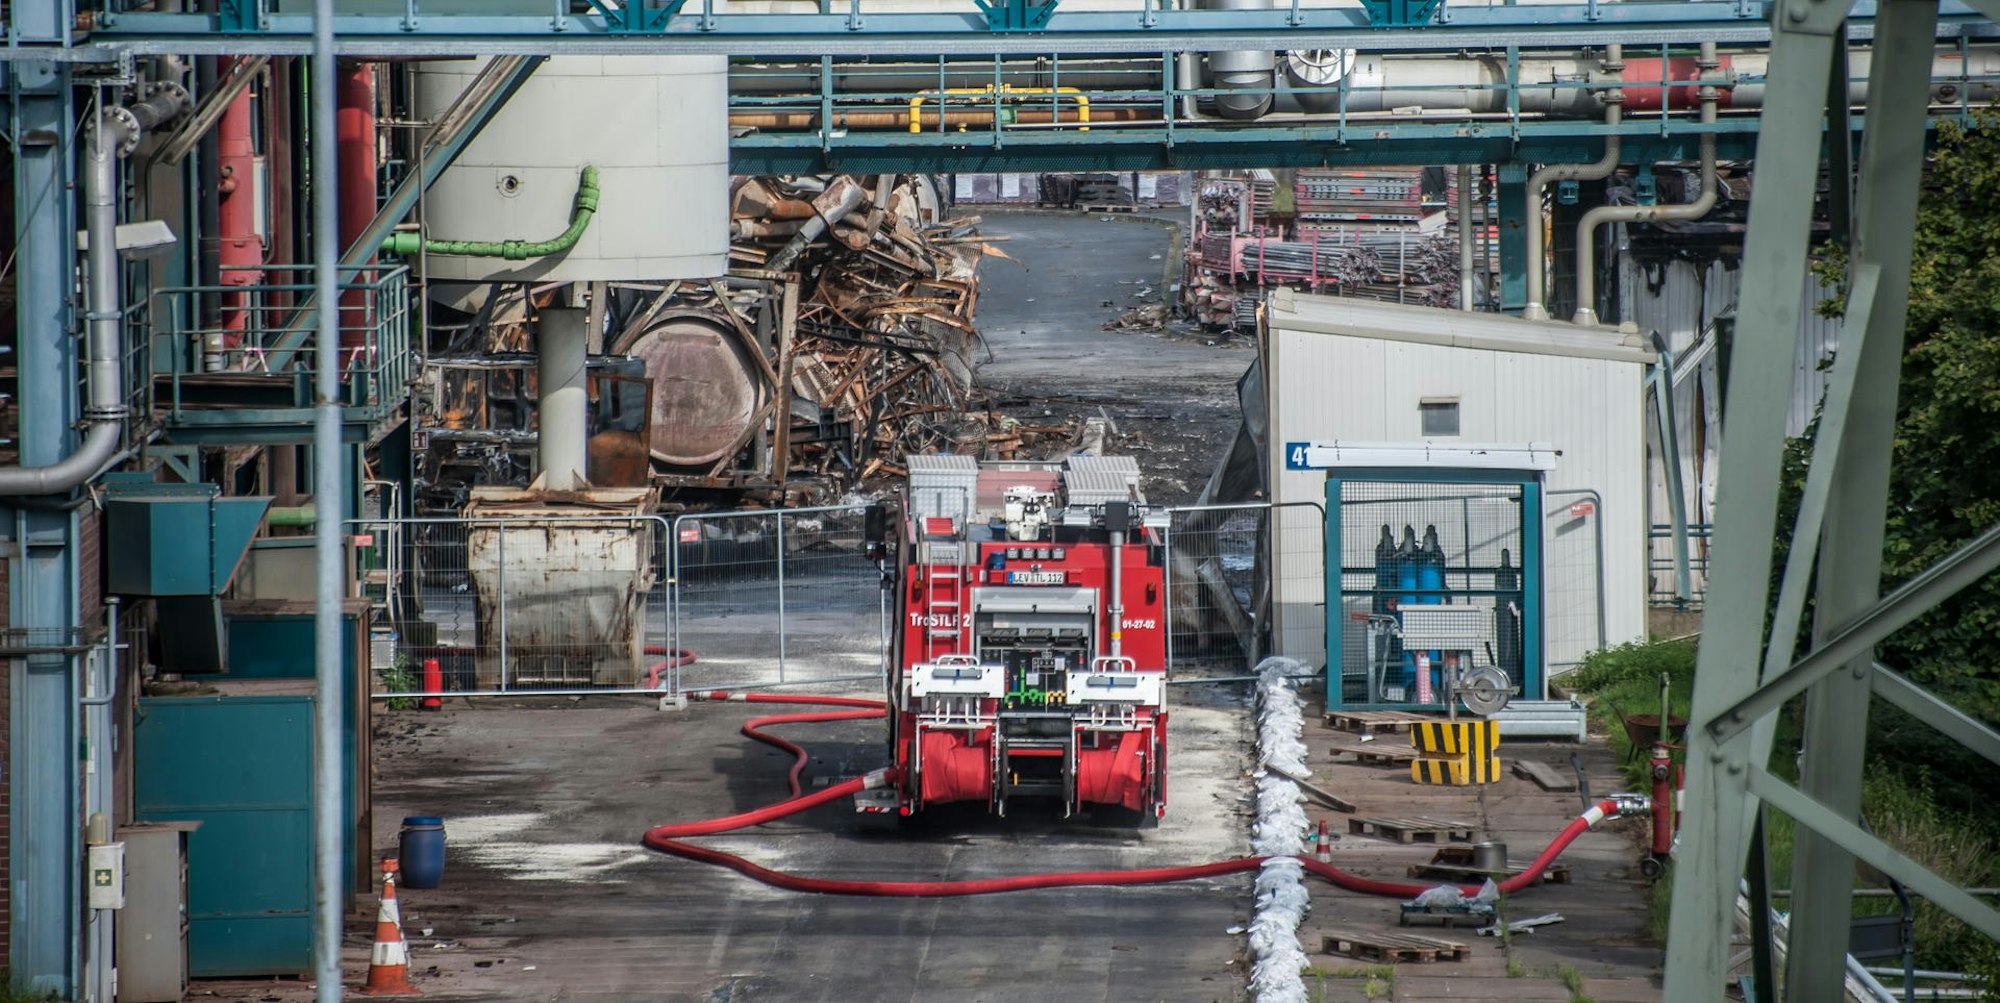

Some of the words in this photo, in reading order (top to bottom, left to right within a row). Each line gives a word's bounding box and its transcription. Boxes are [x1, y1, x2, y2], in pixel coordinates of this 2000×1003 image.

[1014, 573, 1029, 583] LEV
[1035, 573, 1046, 583] TL
[1047, 573, 1064, 583] 112
[962, 613, 971, 628] 2
[1122, 619, 1156, 629] 01-27-02
